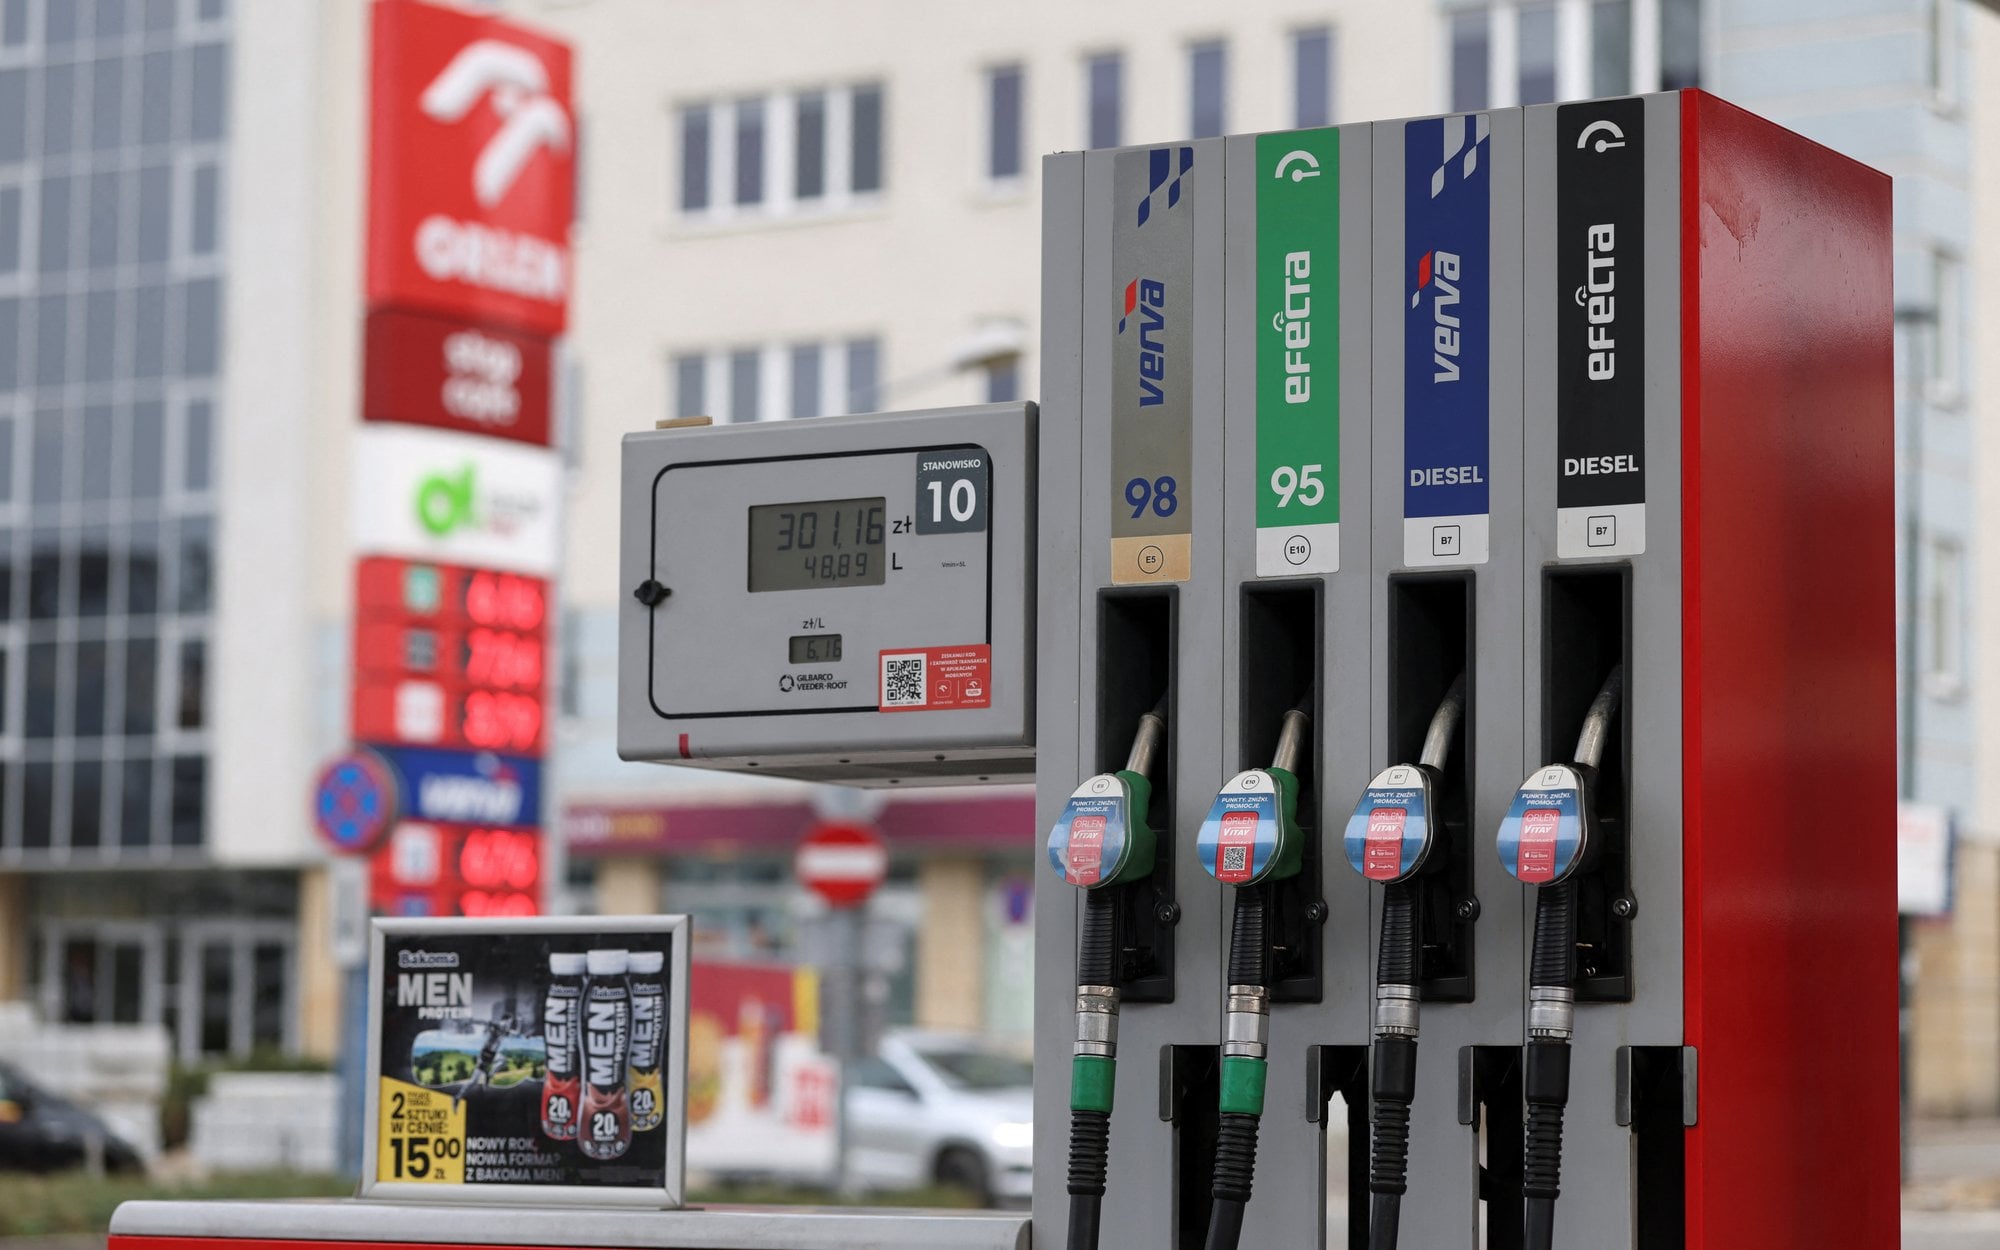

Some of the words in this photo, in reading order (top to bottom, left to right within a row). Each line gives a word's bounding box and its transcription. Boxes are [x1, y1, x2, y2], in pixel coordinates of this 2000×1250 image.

[1588, 223, 1615, 381] efecta
[1434, 250, 1460, 384] verva
[1285, 251, 1310, 404] efecta
[1140, 279, 1164, 408] verva
[923, 459, 981, 471] STANOWISKO
[1564, 455, 1639, 476] DIESEL
[1410, 466, 1483, 486] DIESEL
[1271, 464, 1325, 508] 95
[927, 479, 976, 522] 10
[1125, 476, 1178, 519] 98
[777, 507, 884, 551] 301,16
[893, 515, 912, 534] zł
[1596, 526, 1608, 536] B7
[1290, 545, 1305, 555] E10
[1441, 536, 1452, 545] B7
[805, 553, 867, 580] 48,89
[892, 552, 903, 570] L
[1146, 555, 1156, 564] E5
[802, 617, 825, 630] zł/L
[797, 673, 833, 682] GILBARCO
[1075, 820, 1104, 828] ORLEN
[1225, 817, 1255, 825] ORLEN
[1372, 812, 1403, 820] ORLEN
[1526, 813, 1557, 822] ORLEN
[399, 950, 459, 967] Bakoma
[398, 973, 473, 1007] MEN
[545, 997, 567, 1072] MEN
[631, 996, 653, 1067] MEN
[587, 1002, 615, 1085] MEN
[392, 1092, 405, 1119] 2
[391, 1122, 404, 1133] W
[466, 1137, 507, 1151] NOWY
[391, 1137, 430, 1178] 15
[434, 1138, 461, 1159] 00
[466, 1152, 507, 1165] NOWA
[466, 1168, 474, 1180] Z
[475, 1168, 532, 1180] BAKOMA
